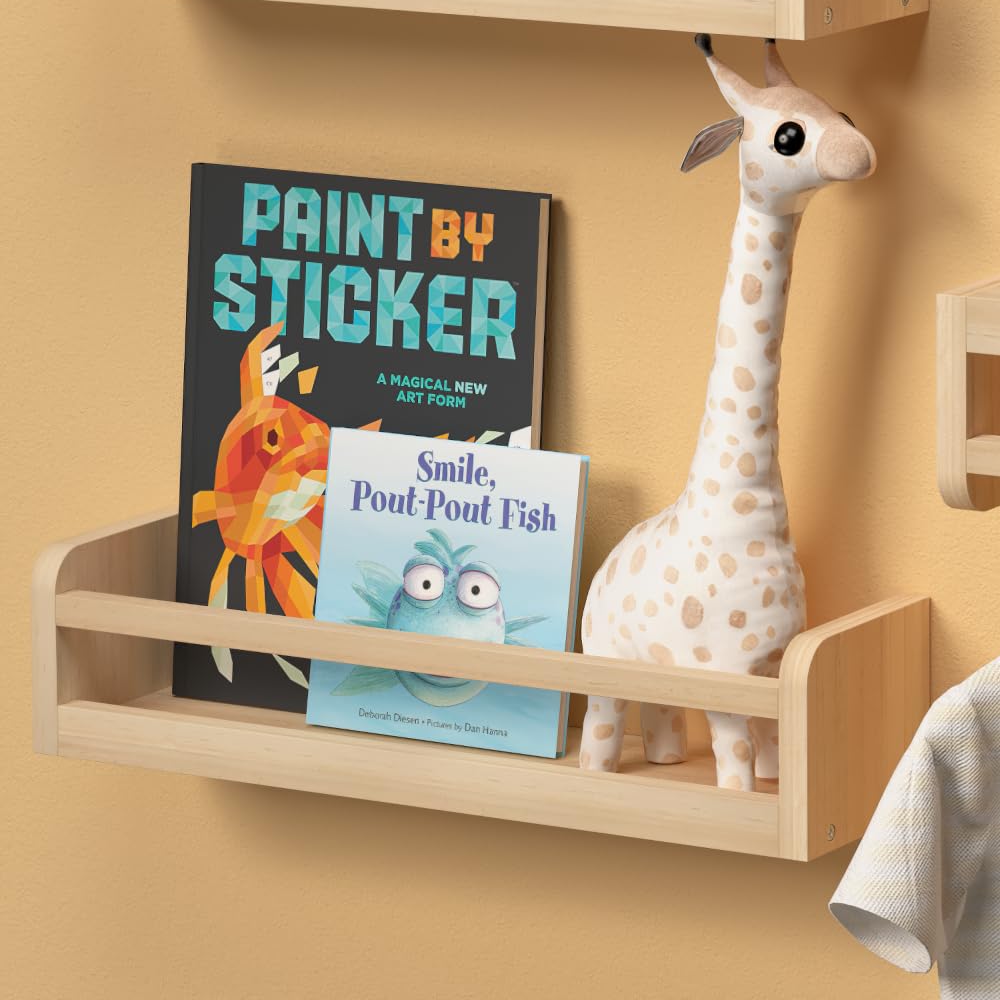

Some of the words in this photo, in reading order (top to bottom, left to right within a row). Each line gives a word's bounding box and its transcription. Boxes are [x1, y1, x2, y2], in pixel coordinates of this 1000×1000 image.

[241, 182, 424, 262] PAINT
[430, 208, 495, 262] BY
[212, 253, 517, 360] STICKER
[376, 373, 387, 385] A
[390, 374, 452, 393] MAGICAL
[454, 381, 487, 396] NEW
[396, 391, 423, 405] ART
[427, 393, 466, 409] FORM
[416, 450, 496, 490] Smile,
[350, 479, 492, 525] Pout-Pout
[498, 497, 557, 533] Fish
[358, 708, 392, 721] Deborah
[393, 712, 420, 725] Diesen
[454, 722, 463, 733] by
[464, 722, 481, 734] Dan
[482, 726, 508, 737] Hanna
